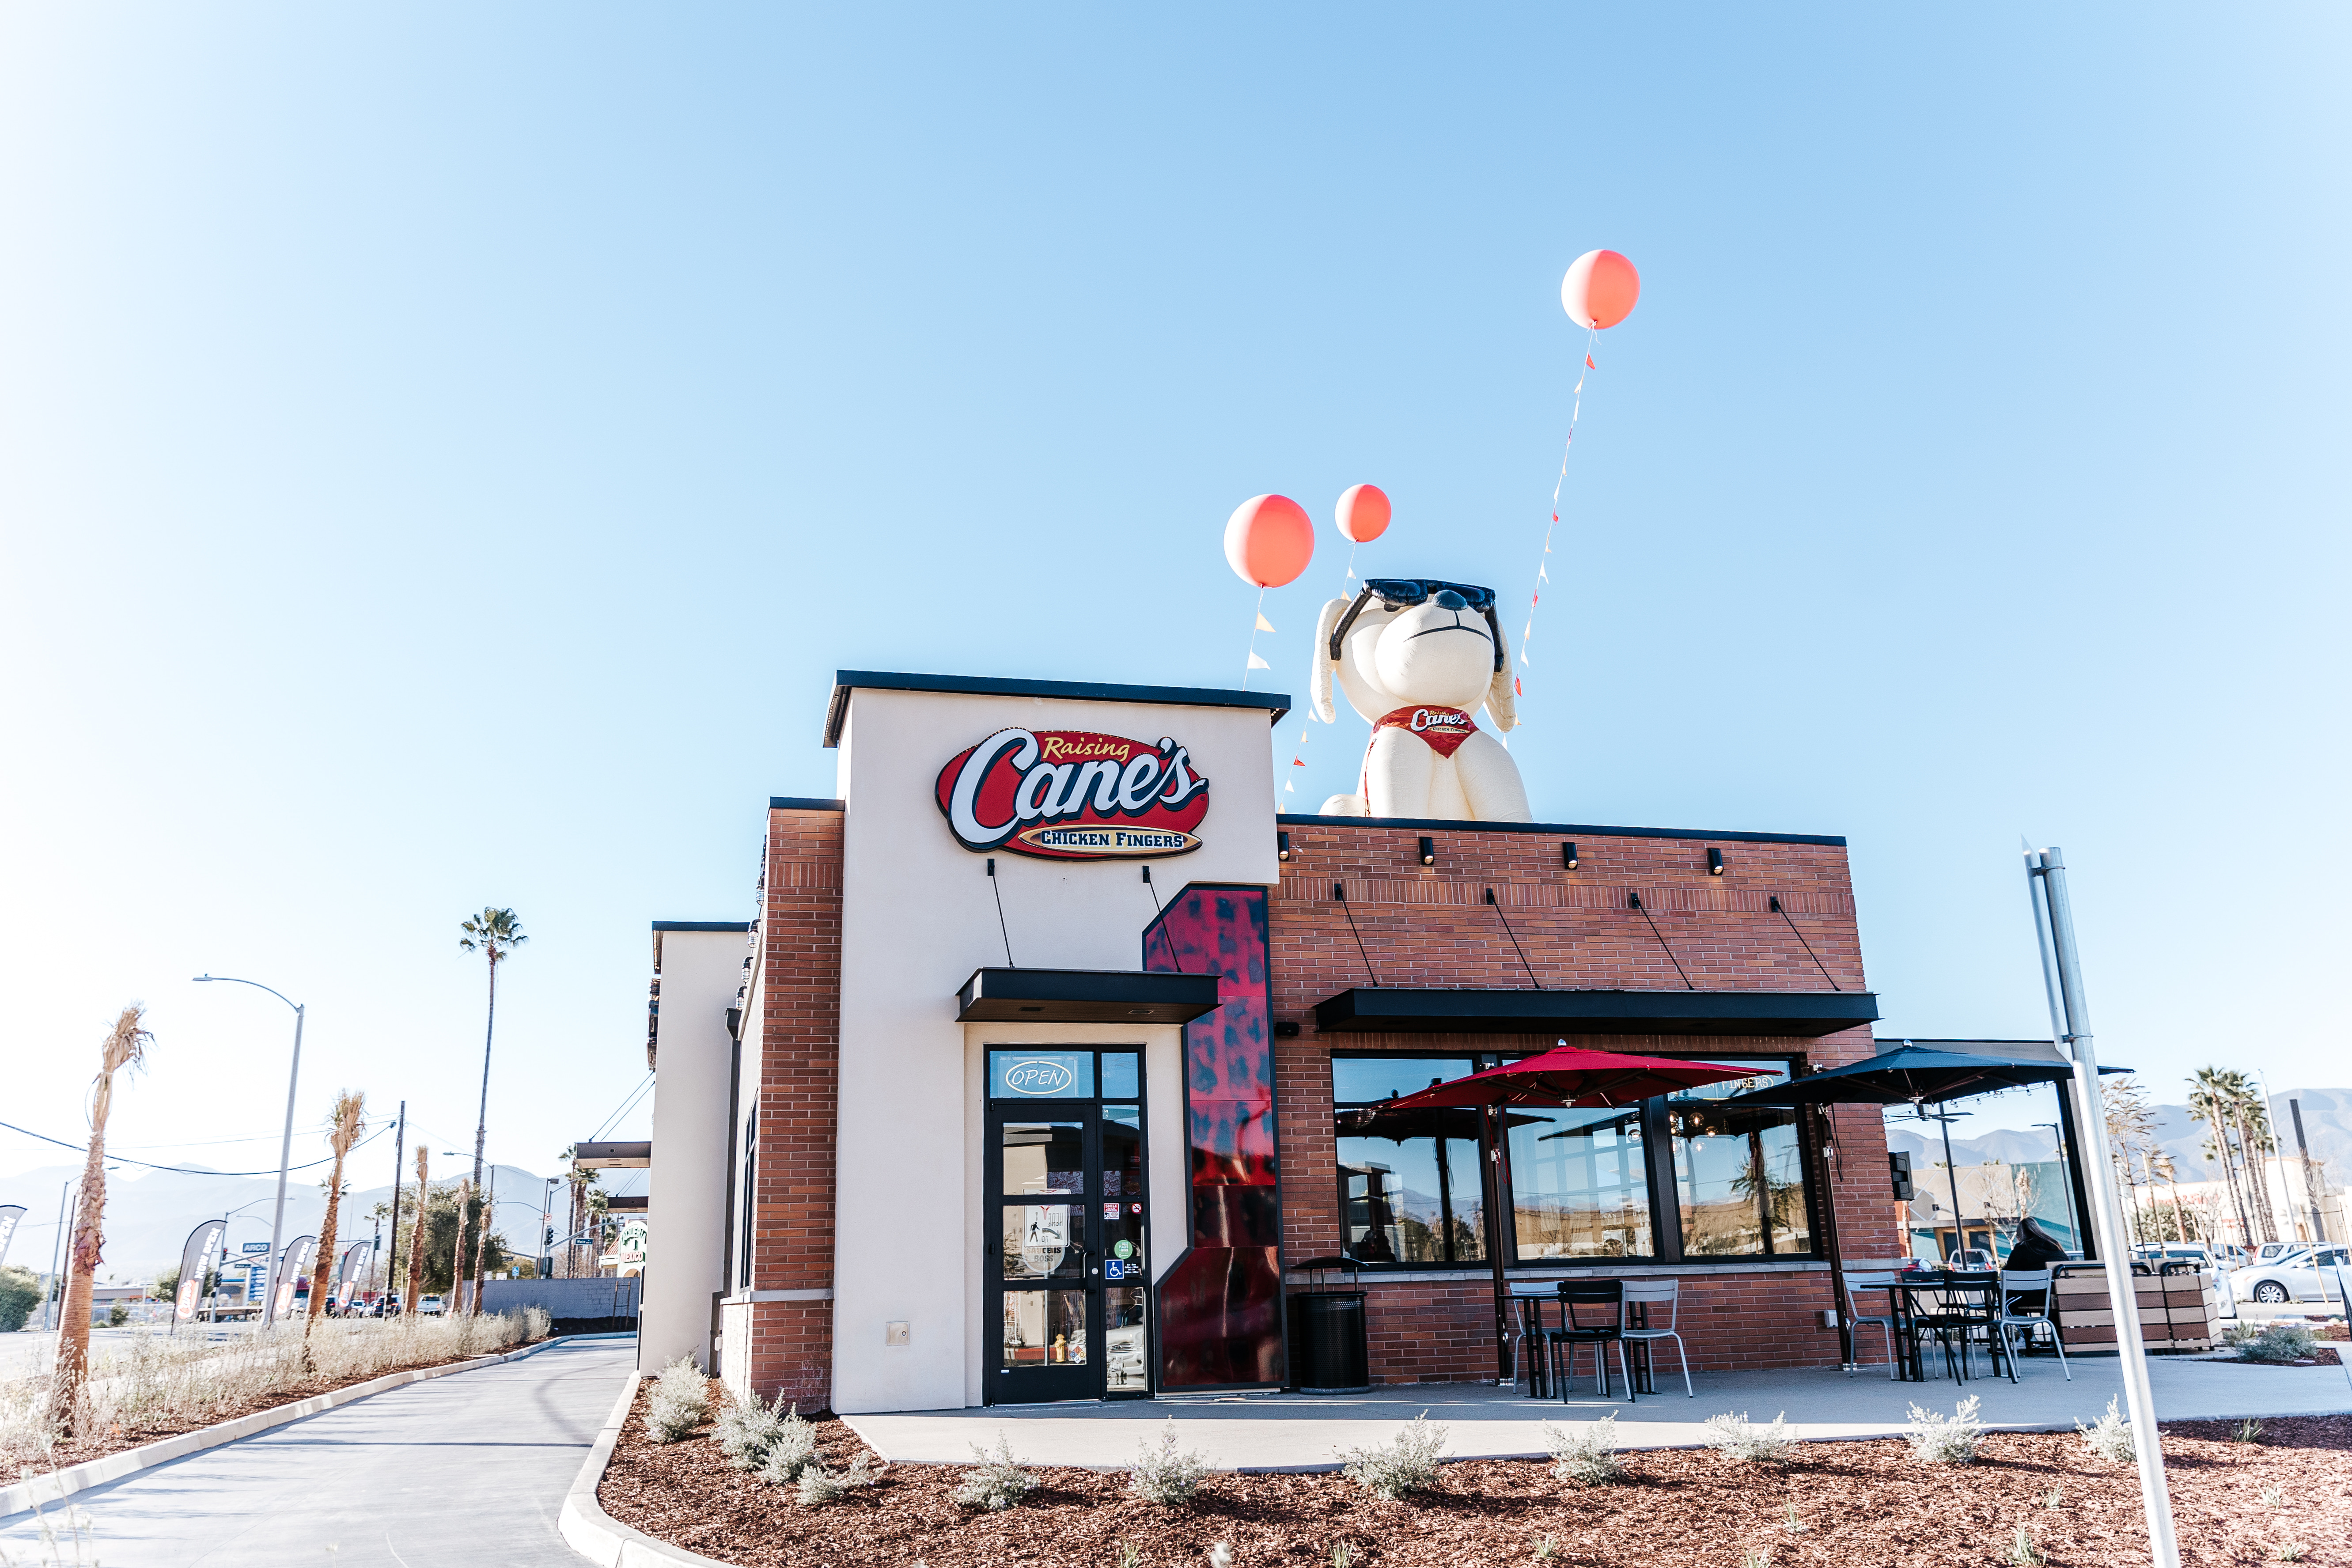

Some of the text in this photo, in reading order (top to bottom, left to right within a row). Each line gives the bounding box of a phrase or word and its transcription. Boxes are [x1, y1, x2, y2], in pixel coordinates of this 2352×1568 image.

[1042, 737, 1130, 762] Raising
[950, 727, 1207, 844] Cane's
[1040, 829, 1185, 849] CHICKEN FINGERS
[1012, 1069, 1064, 1086] OPEN
[1721, 1078, 1769, 1090] FINGERS
[194, 1227, 221, 1280] NOW OPEN
[290, 1241, 311, 1283] NOW OPEN
[621, 1251, 645, 1263] MEXICO
